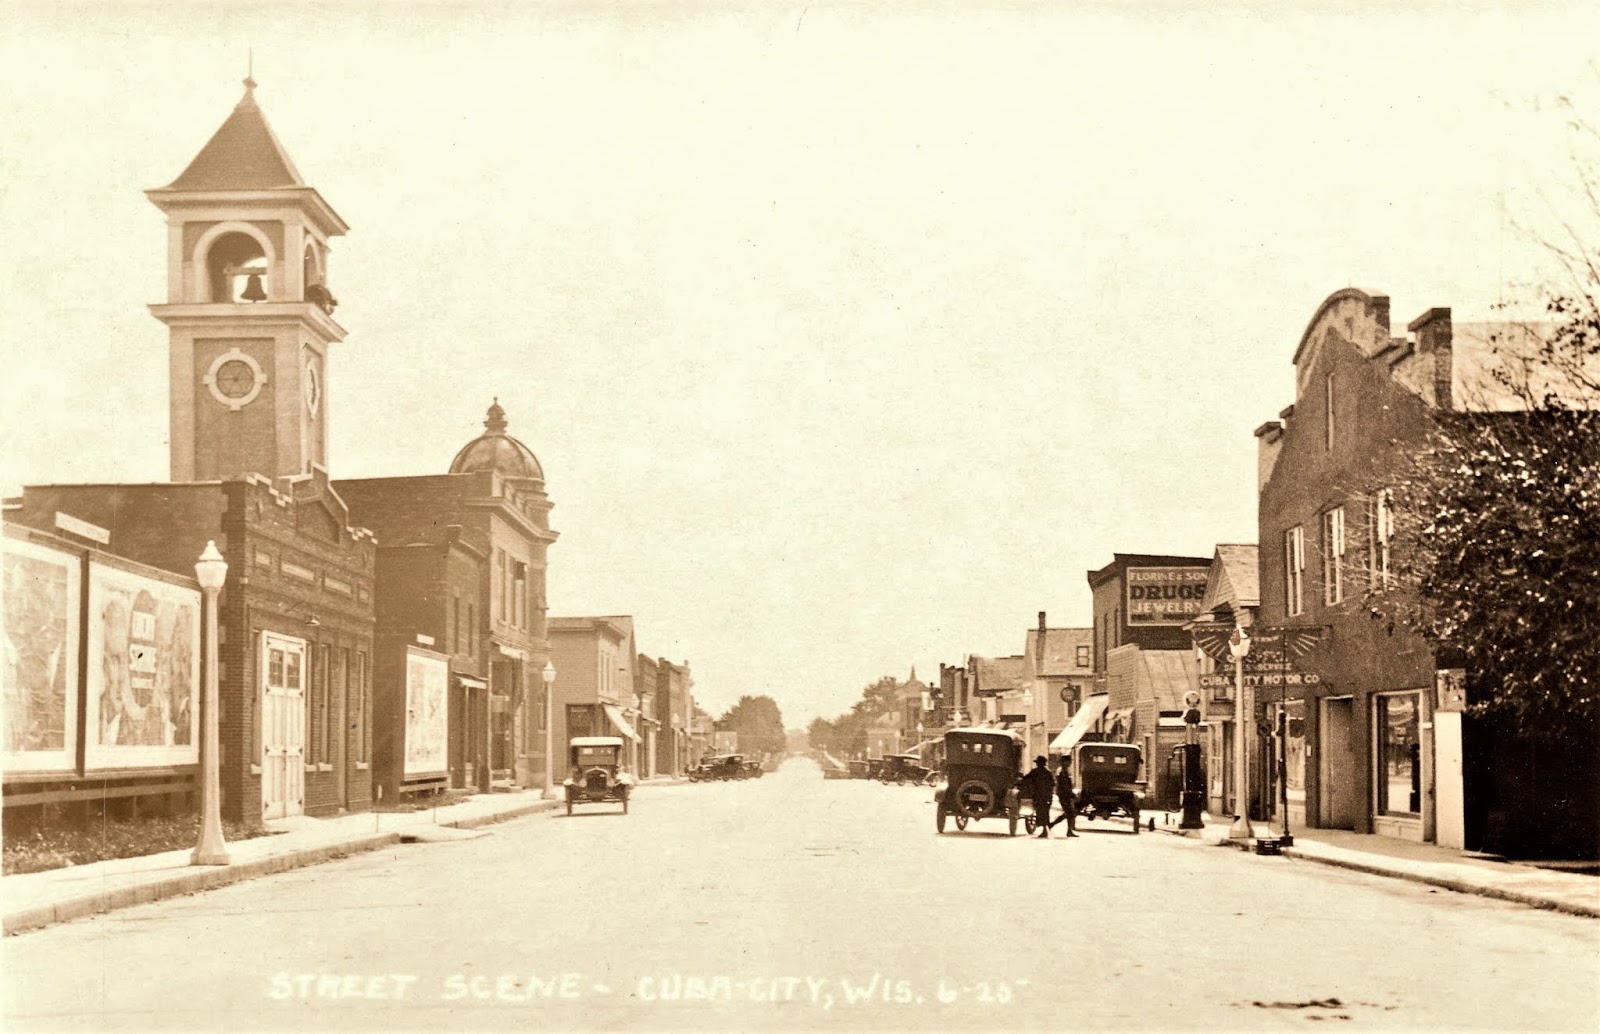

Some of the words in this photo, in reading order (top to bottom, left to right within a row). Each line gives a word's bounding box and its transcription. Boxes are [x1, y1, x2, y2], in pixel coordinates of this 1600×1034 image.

[1130, 585, 1208, 599] DRUGS
[1201, 676, 1230, 686] CUBA
[1304, 674, 1320, 684] CO
